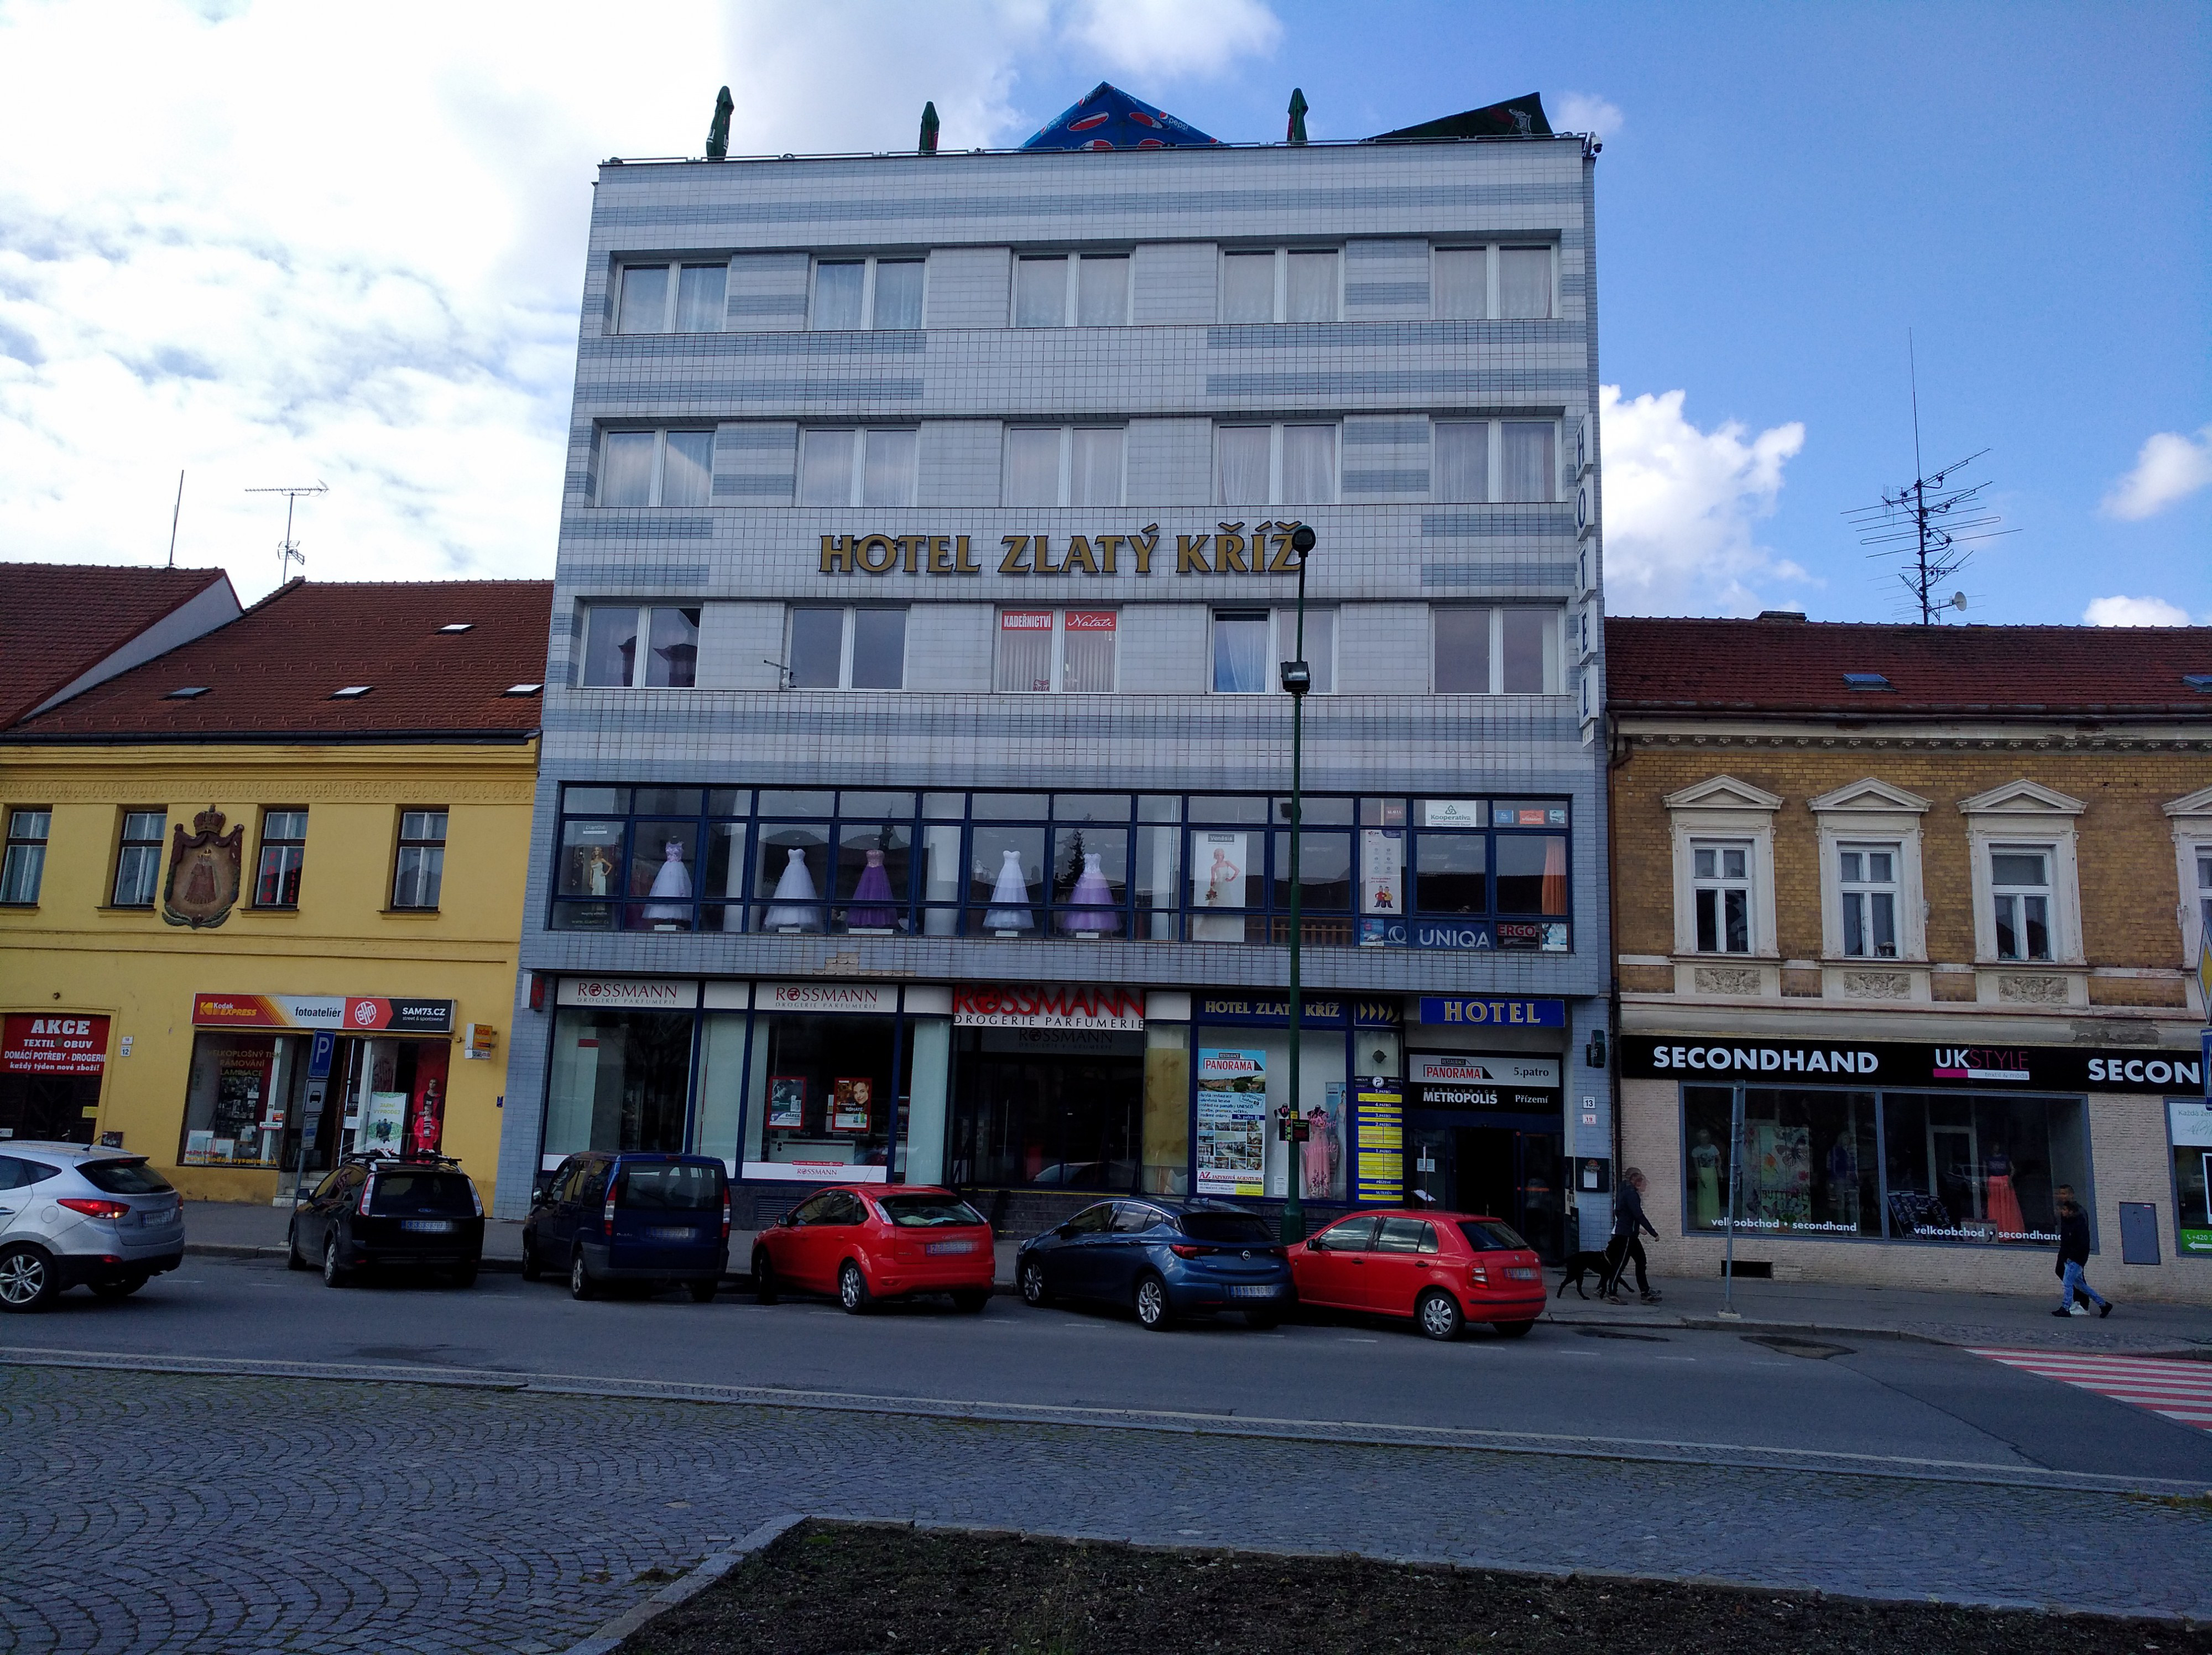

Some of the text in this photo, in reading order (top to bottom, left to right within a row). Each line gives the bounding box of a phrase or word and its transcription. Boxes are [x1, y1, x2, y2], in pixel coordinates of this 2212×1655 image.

[1168, 117, 1188, 132] pepsi
[818, 520, 1302, 574] HOTEL ZLATÝ KŘÍŽ
[1004, 613, 1052, 628] KADEŘNICTVÍ
[1497, 924, 1536, 937] ERGO
[1419, 929, 1490, 948] UNIQA
[578, 983, 677, 998] ROSSMANN
[775, 987, 878, 1003] ROSSMANN
[953, 985, 1144, 1018] ROSSMANN
[220, 1008, 257, 1016] EXPRESS
[295, 1006, 342, 1018] fotoateliér
[402, 1007, 446, 1016] SAM73.CZ
[1205, 1001, 1340, 1018] HOTEL ZLAT KŘÍŽ
[1444, 1001, 1541, 1023] HOTEL
[30, 1019, 91, 1035] AKCE
[954, 1014, 1144, 1029] DROGERIE PARFUMERIE
[23, 1039, 93, 1049] TEXTIL OBUV
[316, 1037, 330, 1063] P
[4, 1049, 33, 1060] DOMÁCÍ
[33, 1050, 67, 1061] POTŘEBY
[1653, 1045, 1879, 1074] SECONDHAND
[9, 1061, 32, 1071] každý
[34, 1062, 55, 1071] týden
[76, 1063, 101, 1072] zboží!
[1206, 1060, 1253, 1071] PANORAMA
[1426, 1066, 1549, 1079] PANORAMA 5.patro
[2088, 1058, 2200, 1084] SECON
[1423, 1091, 1549, 1105] METROPOLIS Přízemí
[1792, 1220, 1858, 1232] secondhand
[1913, 1225, 1985, 1238] velkoobchod
